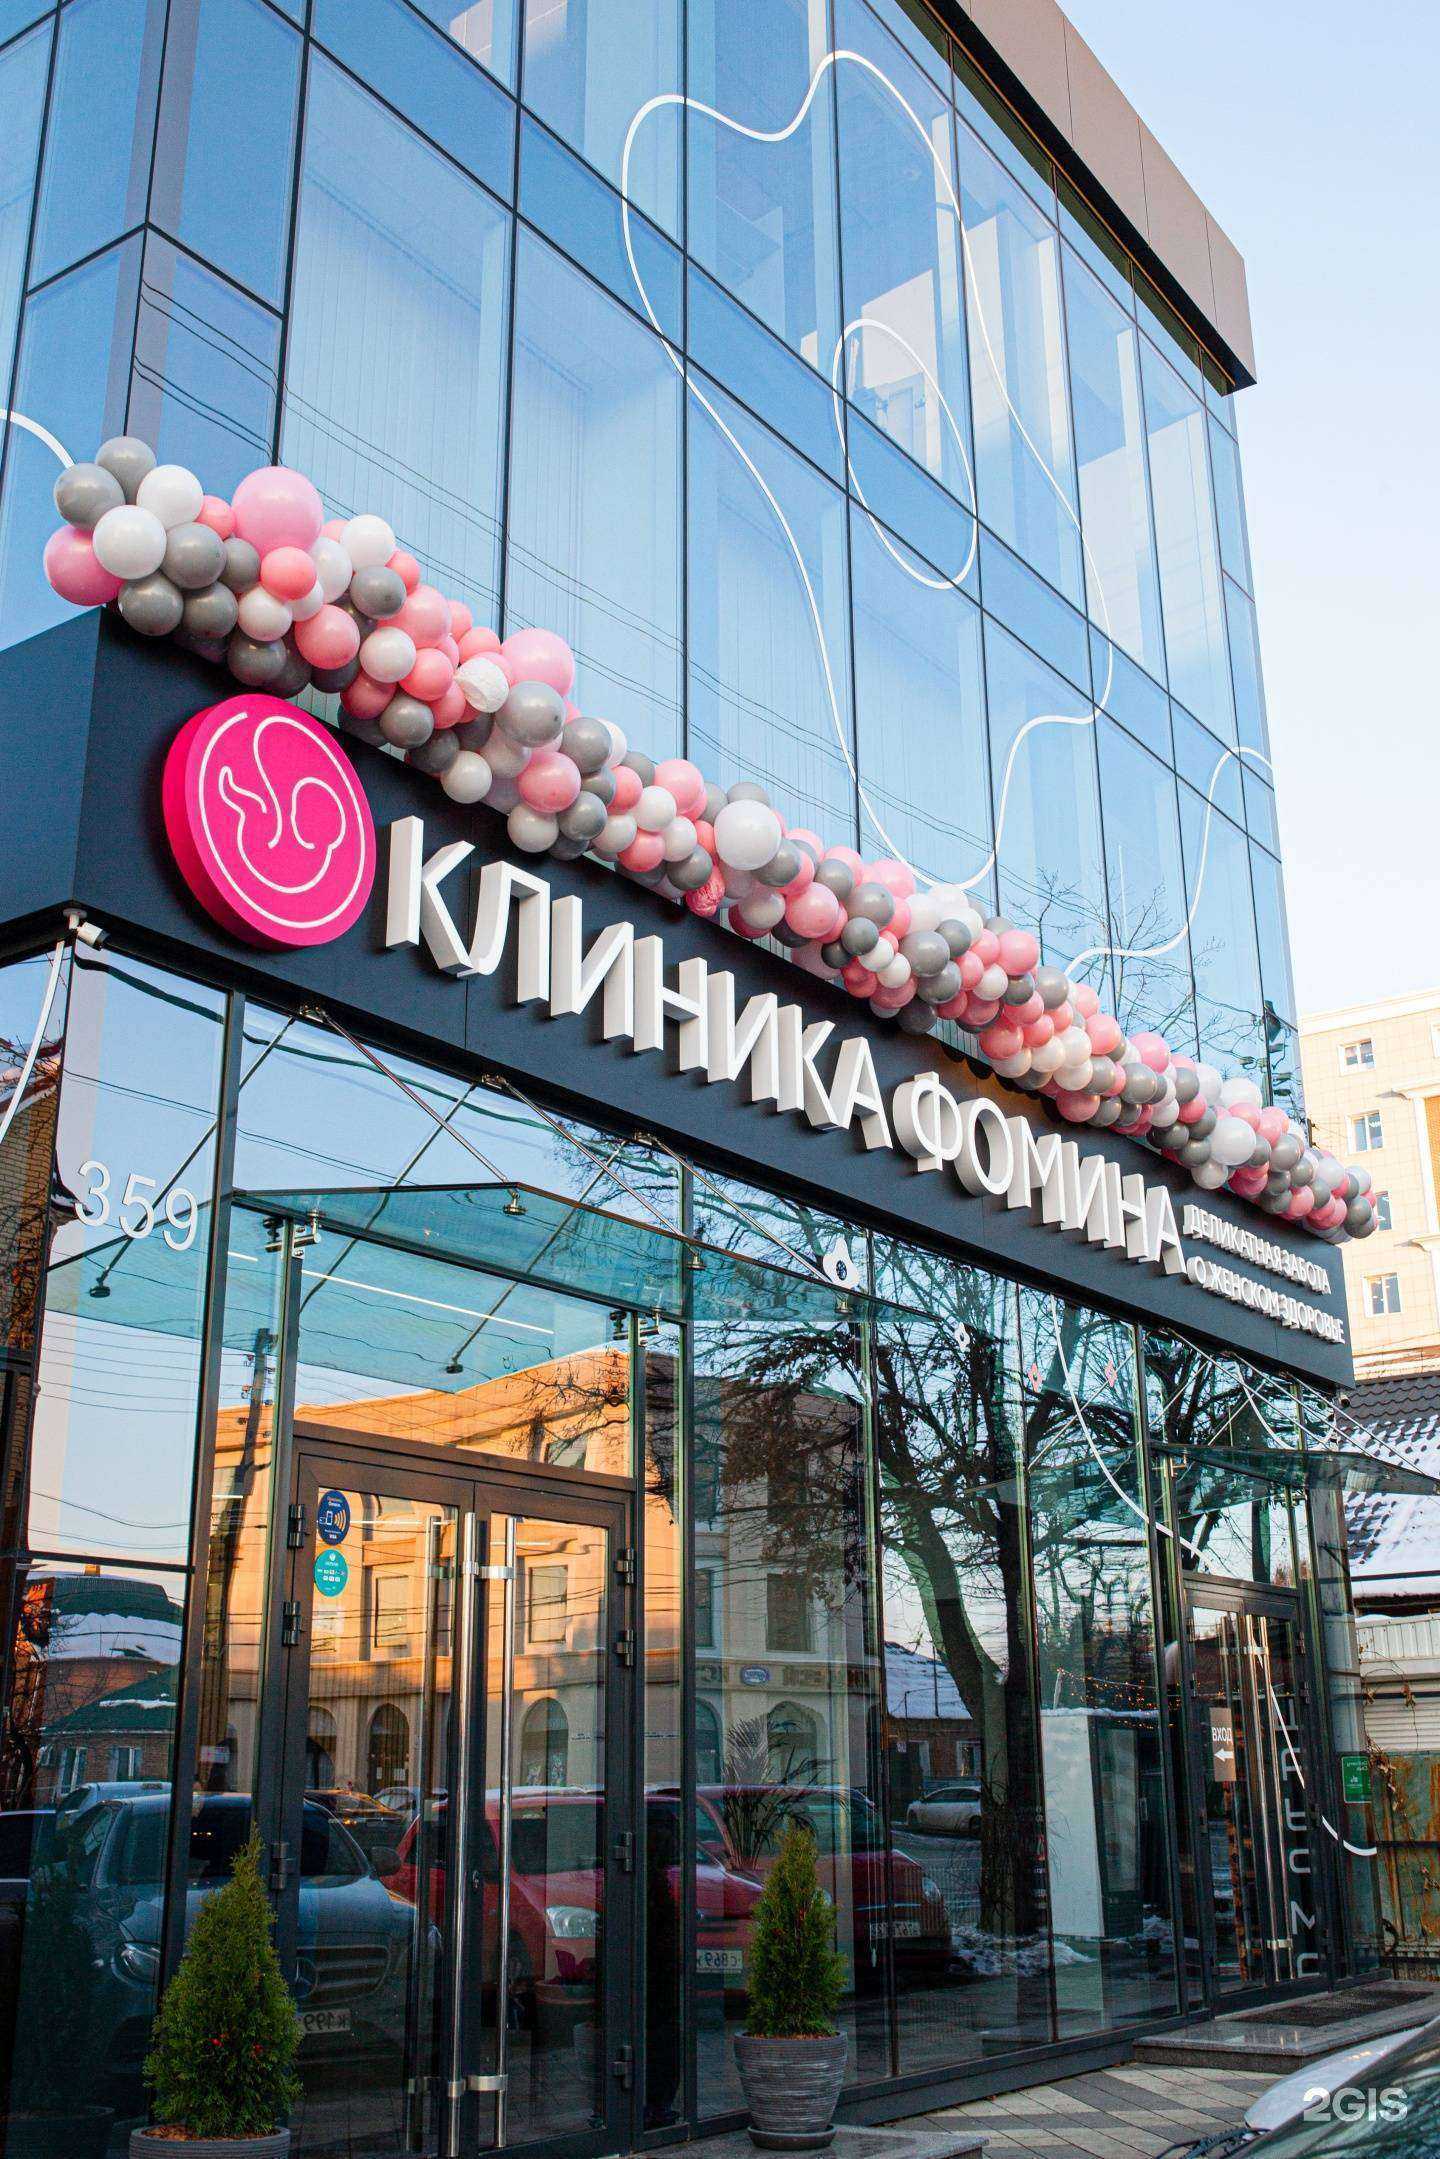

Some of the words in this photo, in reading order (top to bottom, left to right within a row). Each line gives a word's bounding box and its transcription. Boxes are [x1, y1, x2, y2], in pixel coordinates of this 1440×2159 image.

[385, 815, 892, 1149] КЛИНИКА
[893, 1070, 1187, 1276] ФОМИНА
[75, 1160, 197, 1251] 359
[1183, 1204, 1281, 1275] ДЕЛИКАТНАЯ
[1280, 1249, 1331, 1295] ЗАБОТА
[1187, 1256, 1206, 1284] О
[1203, 1261, 1280, 1319] ЖЕНСКОМ
[1278, 1294, 1345, 1344] ЗДОРОВЬЕ
[1211, 1726, 1233, 1744] ВХОД
